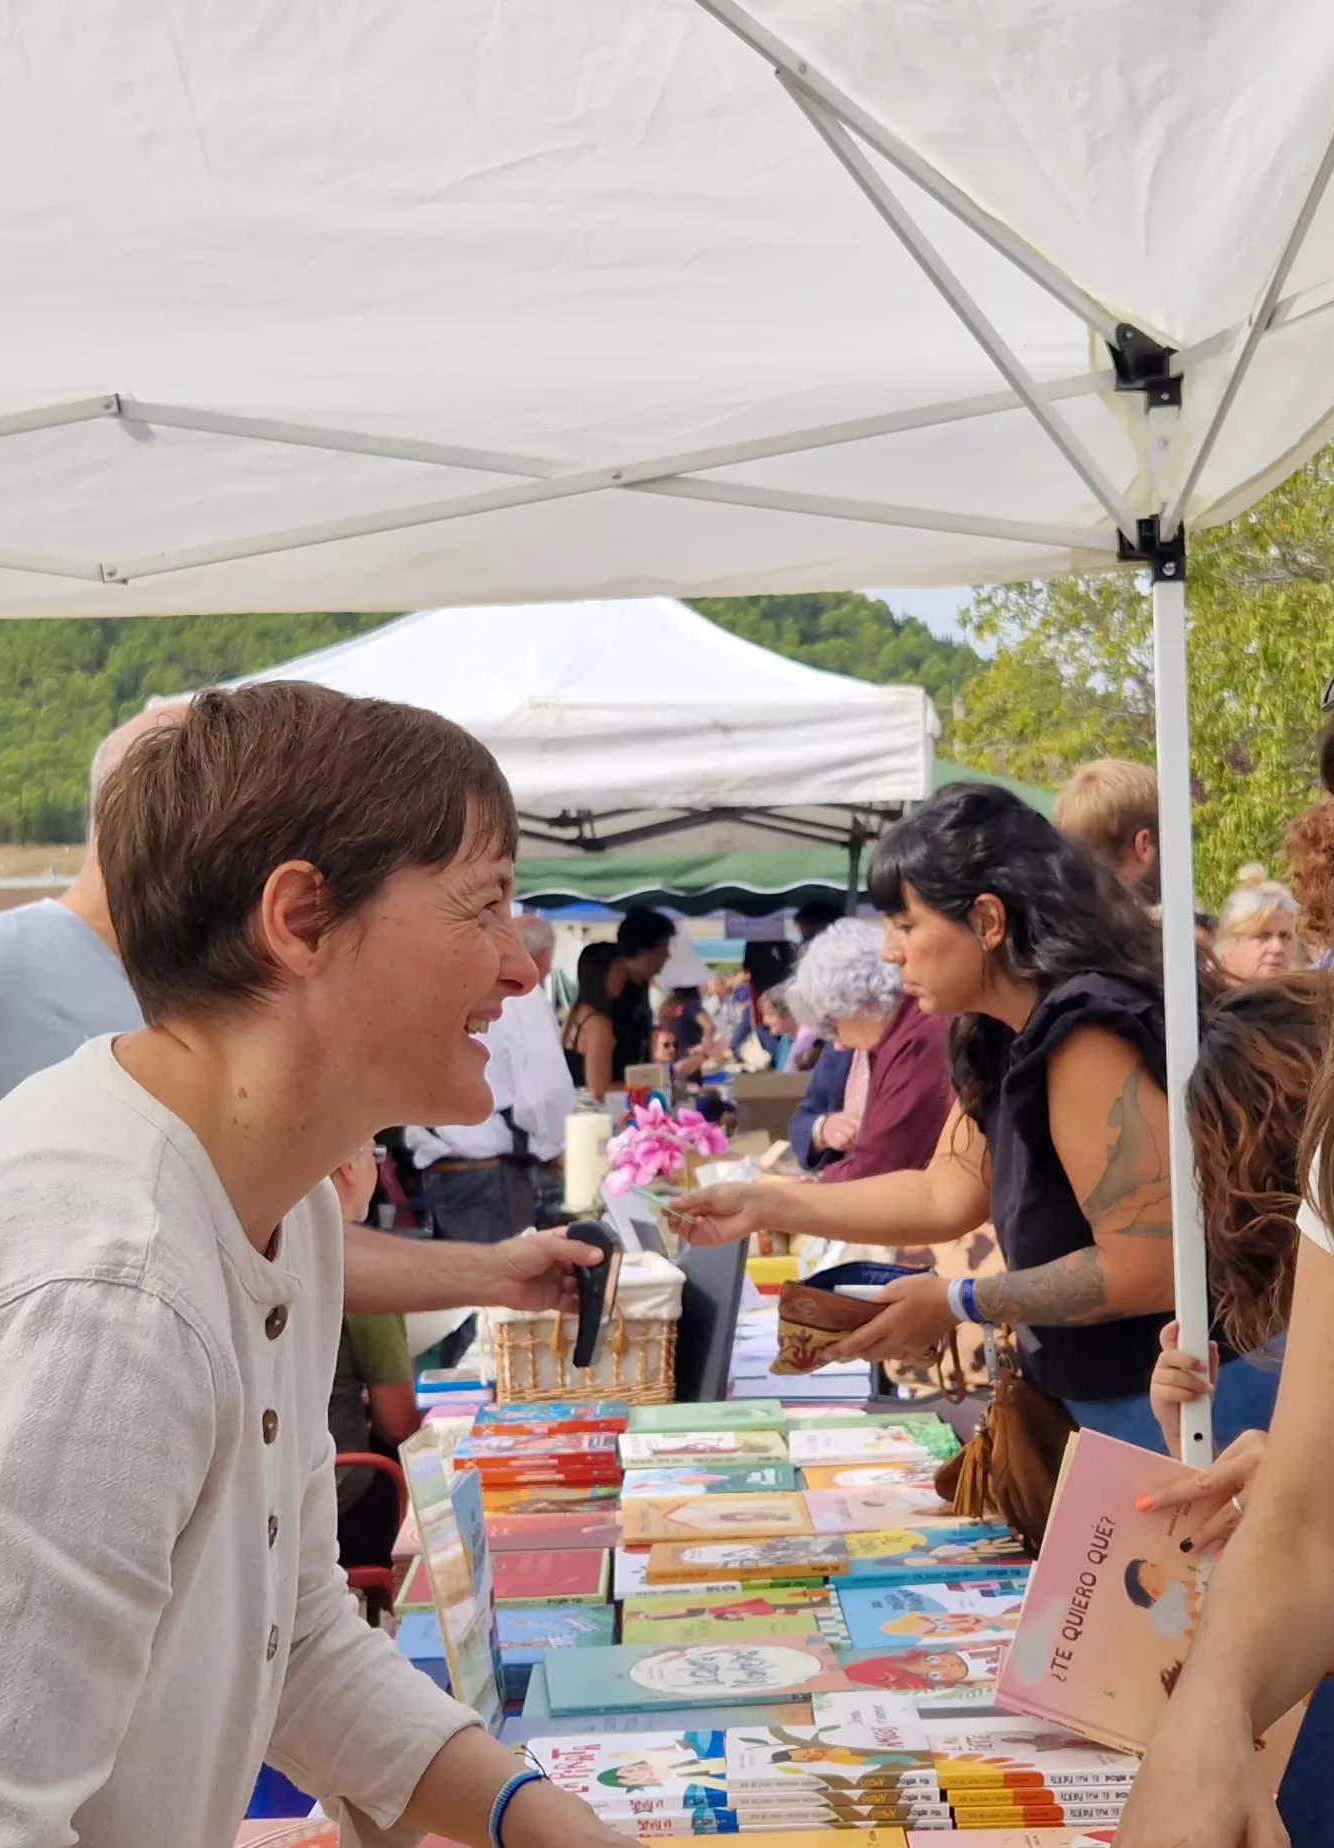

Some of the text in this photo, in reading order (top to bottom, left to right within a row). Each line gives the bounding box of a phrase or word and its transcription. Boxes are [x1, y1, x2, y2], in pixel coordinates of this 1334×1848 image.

[1087, 1515, 1117, 1566] QUÉ?
[1061, 1571, 1097, 1642] QUIERO
[1050, 1646, 1073, 1683] ¿TE
